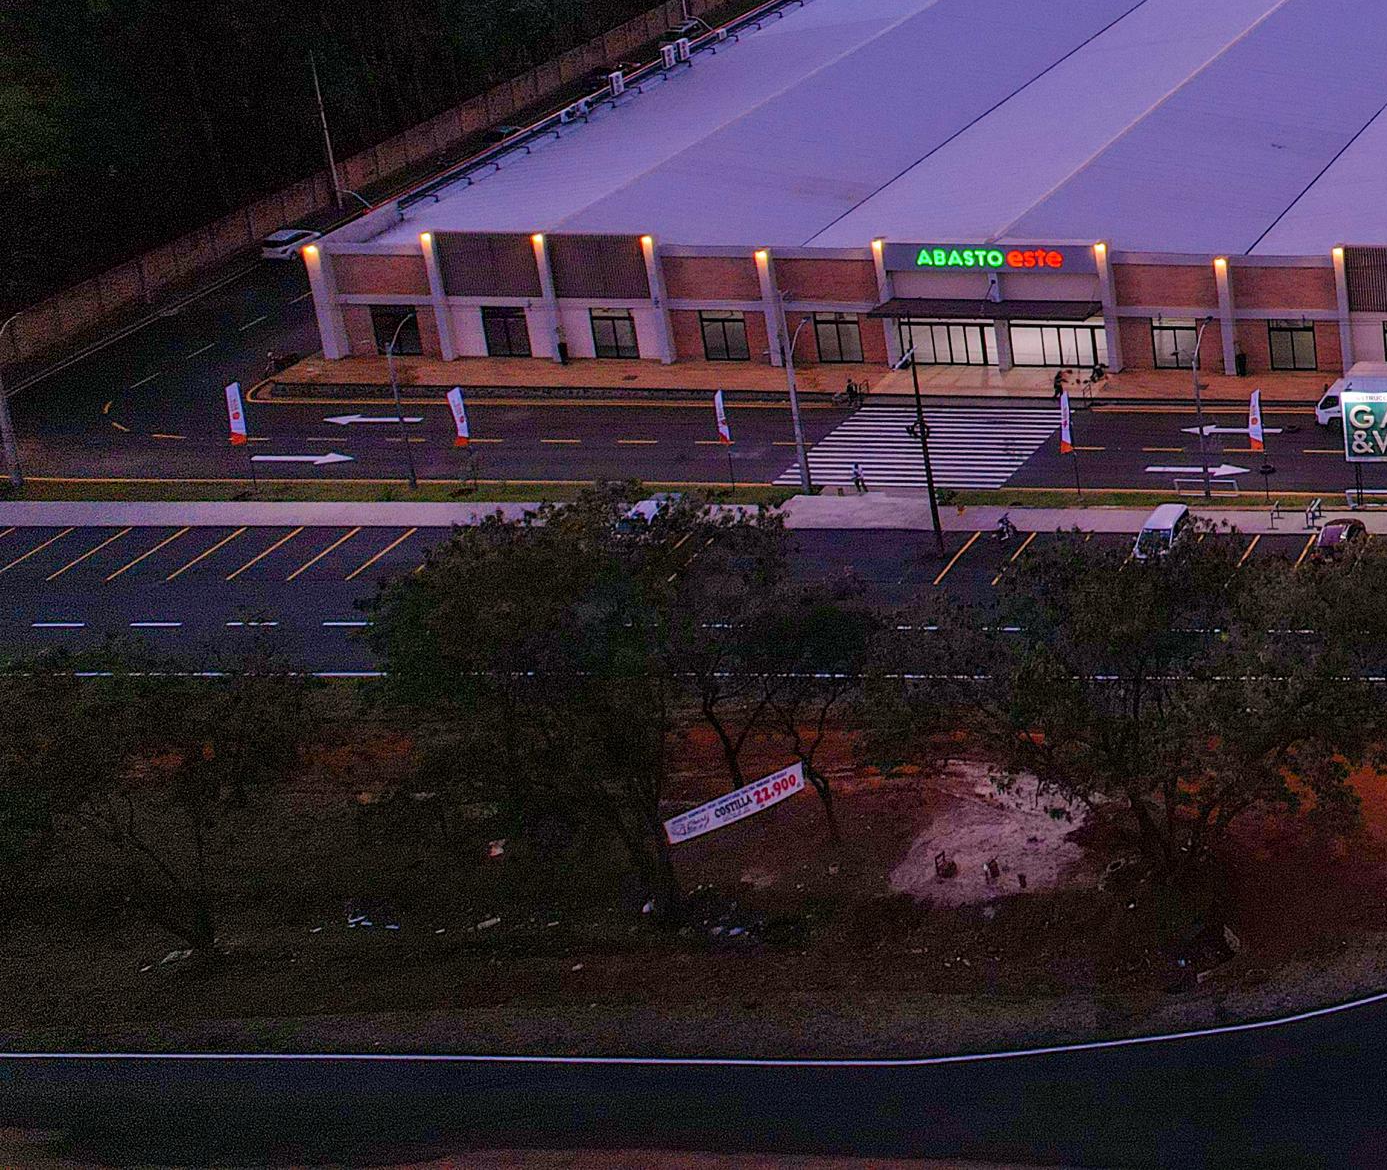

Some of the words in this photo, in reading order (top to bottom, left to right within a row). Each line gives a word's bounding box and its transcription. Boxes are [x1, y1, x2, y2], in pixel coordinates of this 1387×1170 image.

[917, 248, 1004, 267] ABASTO
[1006, 248, 1063, 267] este
[714, 794, 753, 818] COSTILLA
